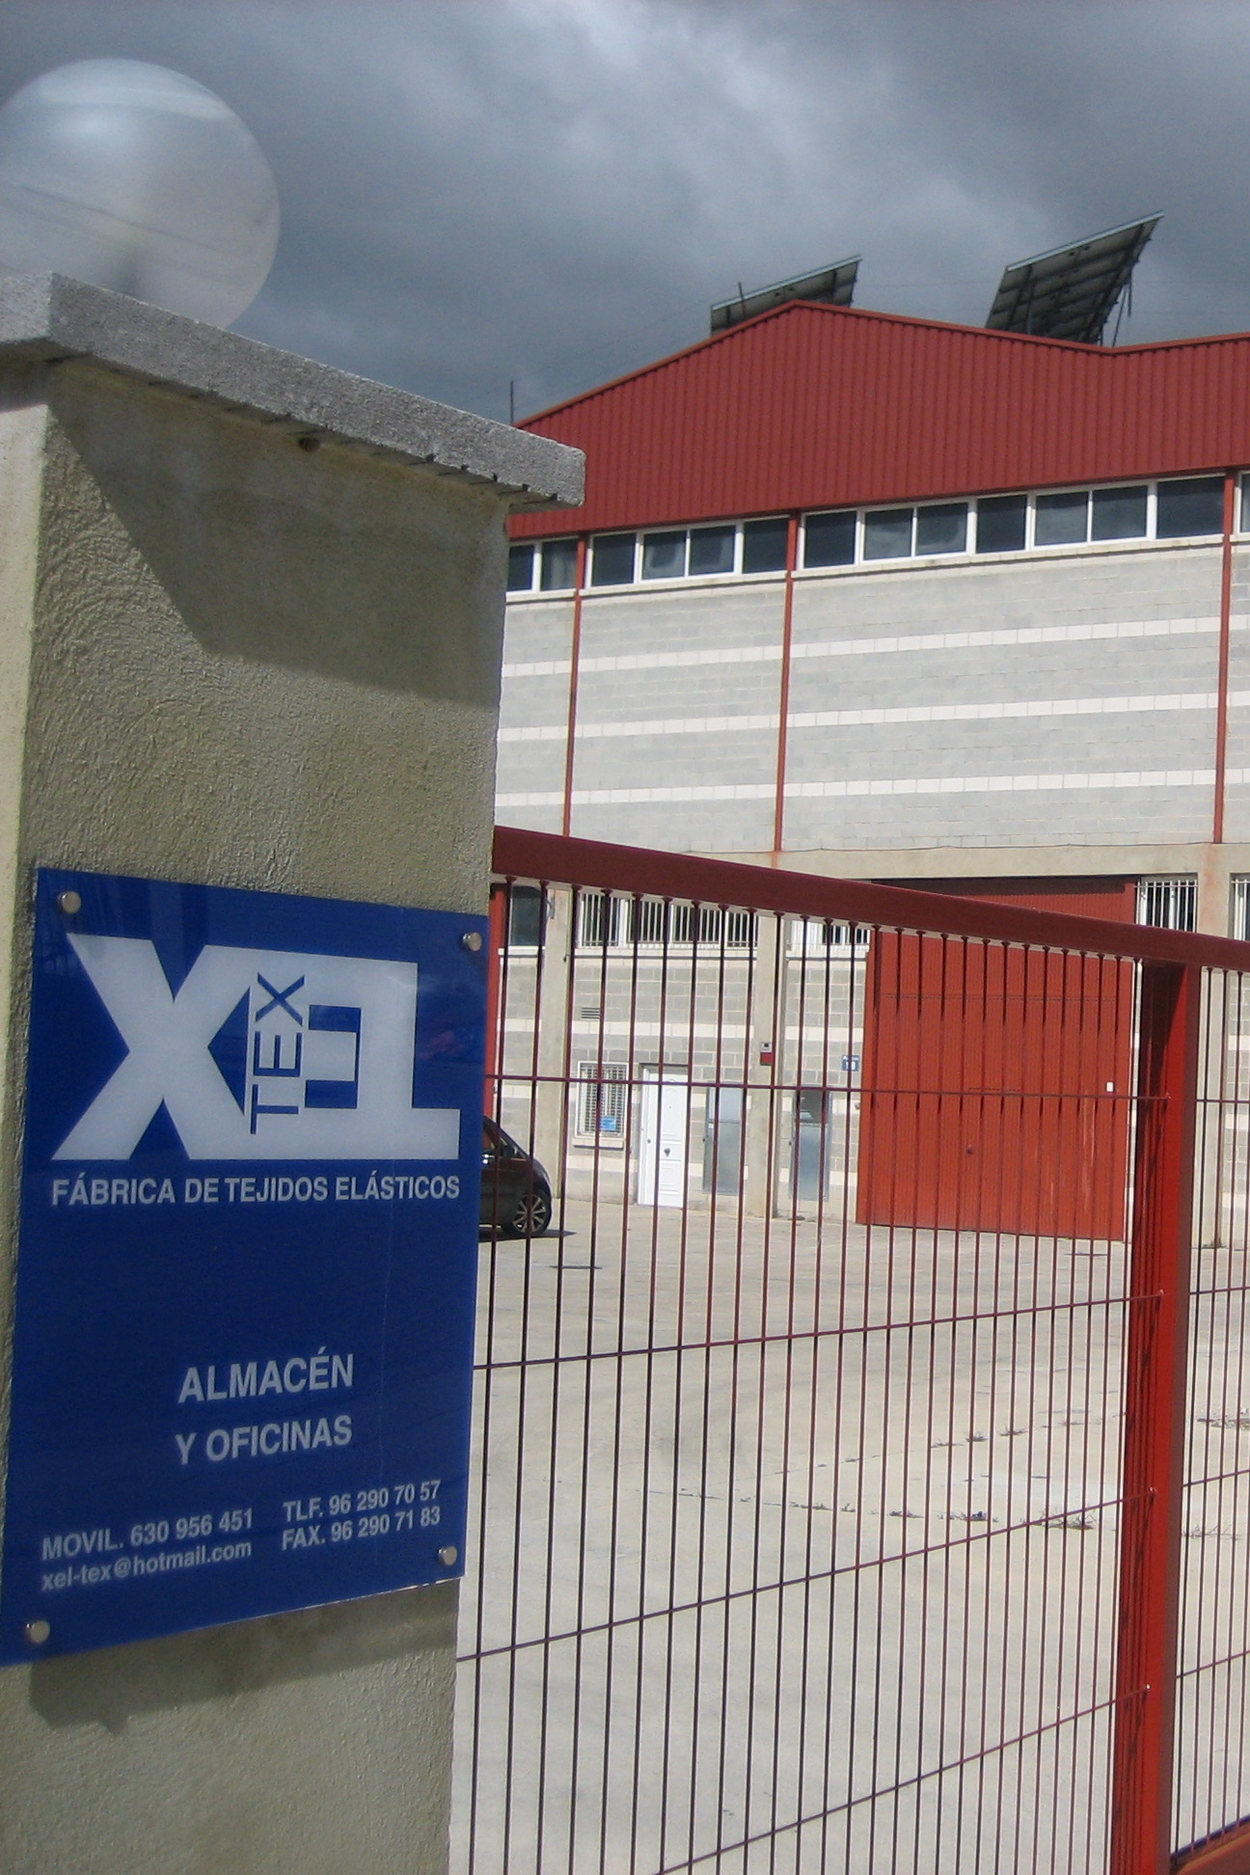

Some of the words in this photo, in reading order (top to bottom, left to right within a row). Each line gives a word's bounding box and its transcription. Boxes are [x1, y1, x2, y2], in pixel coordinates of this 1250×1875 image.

[250, 972, 306, 1135] TEX
[52, 1172, 176, 1207] FÁBRICA
[184, 1178, 219, 1204] DE
[224, 1176, 329, 1203] TEJIDOS
[335, 1170, 461, 1201] ELÁSTICOS
[177, 1346, 355, 1405] ALMACÉN
[174, 1431, 197, 1466] Y
[205, 1414, 353, 1463] OFICINAS
[282, 1496, 324, 1523] TLF.
[328, 1493, 352, 1517] 96
[355, 1487, 390, 1513] 290
[393, 1483, 416, 1506] 70
[419, 1479, 442, 1502] 57
[41, 1527, 125, 1562] MOVIL.
[129, 1519, 170, 1548] 630
[174, 1512, 214, 1541] 956
[217, 1506, 254, 1532] 451
[281, 1523, 327, 1552] FAX.
[330, 1519, 353, 1543] 96
[357, 1513, 391, 1539] 290
[394, 1509, 415, 1532] 71
[419, 1504, 441, 1528] 83
[40, 1540, 253, 1593] xel-tex@hotmail.com
